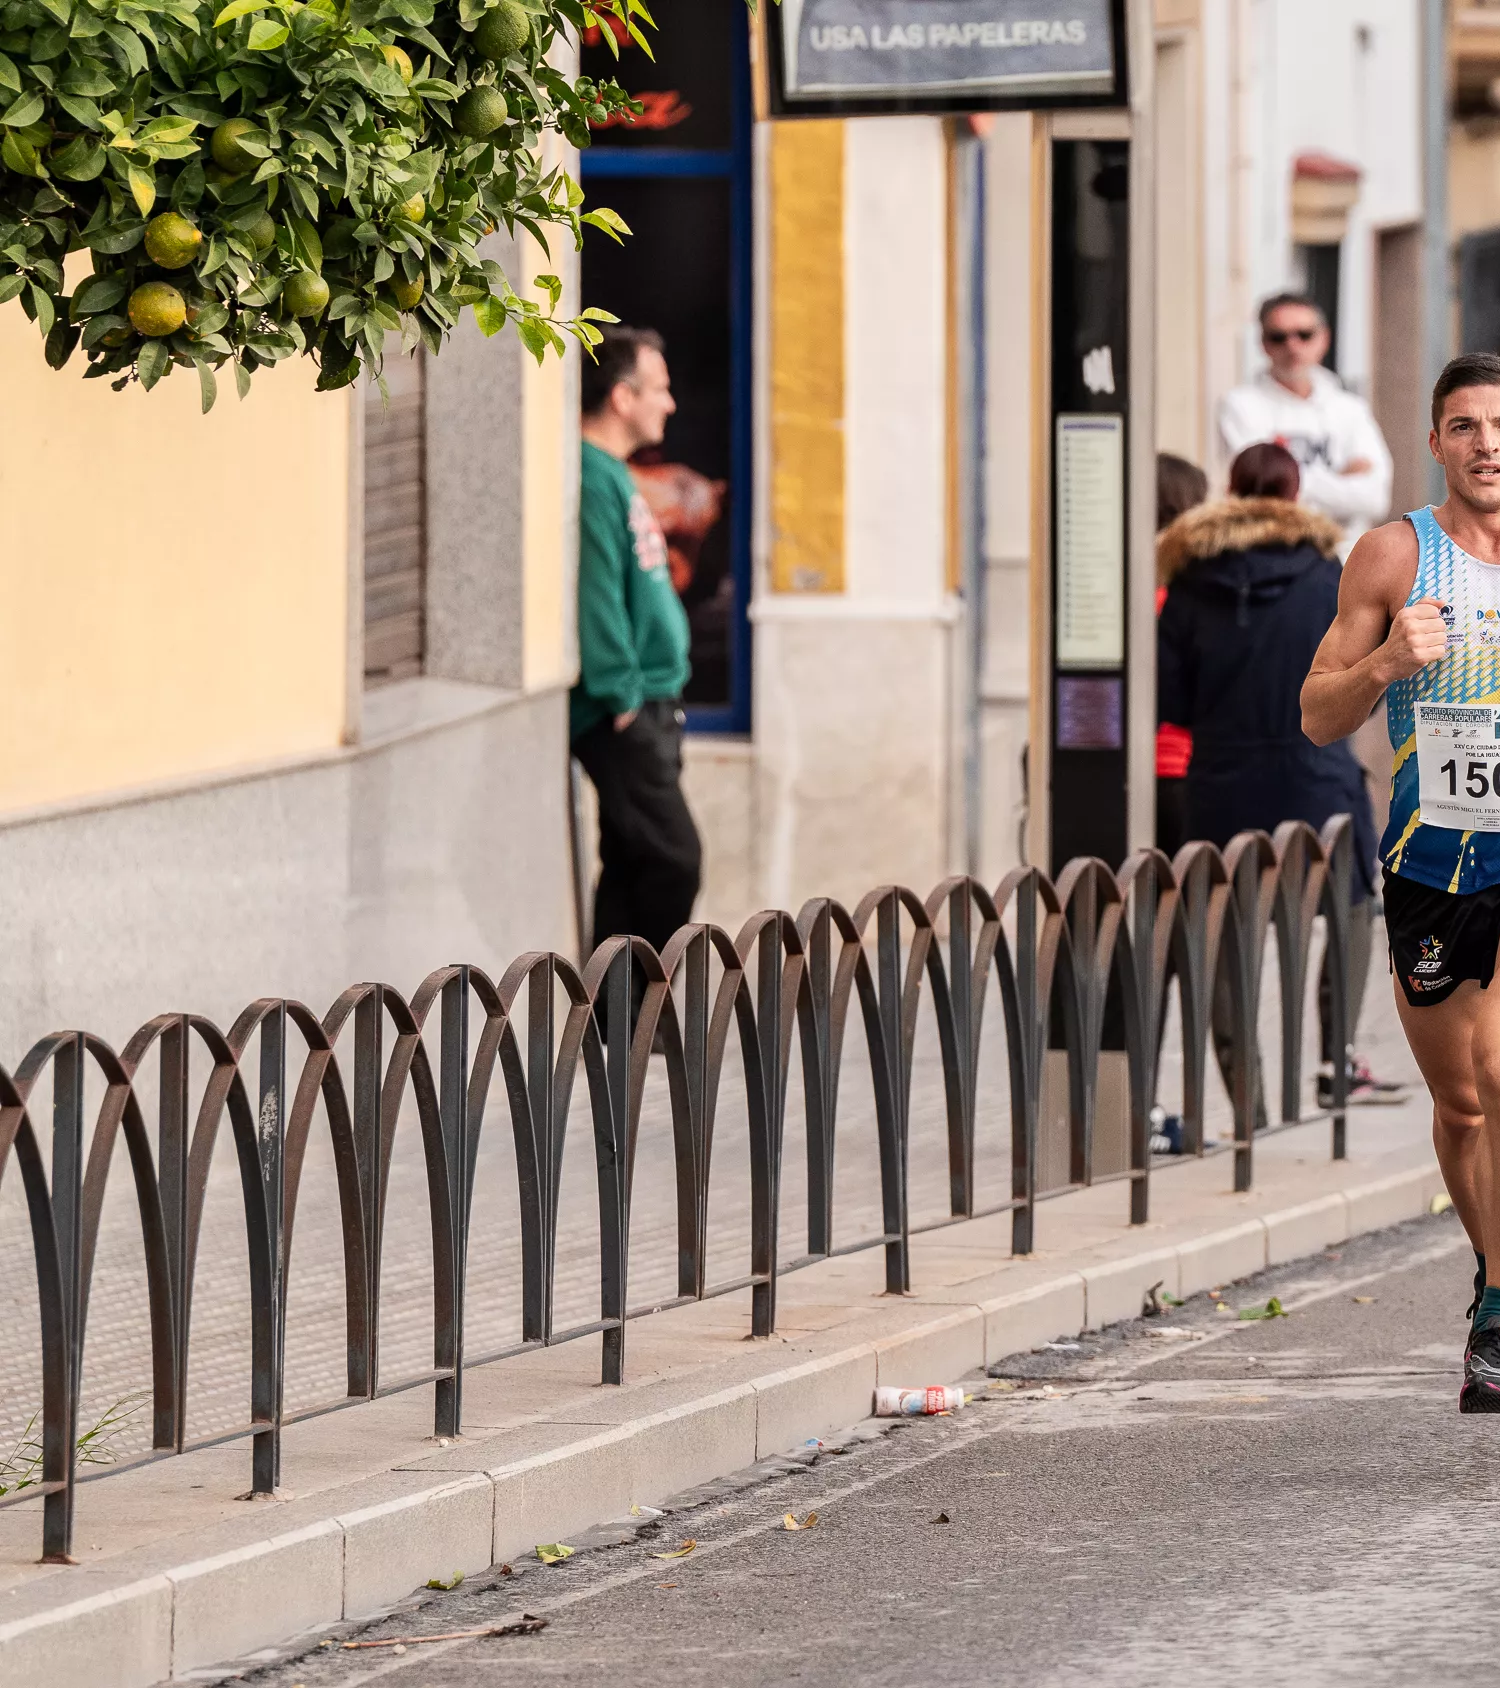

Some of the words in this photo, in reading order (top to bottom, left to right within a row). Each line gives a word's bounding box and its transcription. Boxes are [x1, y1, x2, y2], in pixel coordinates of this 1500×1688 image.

[811, 26, 867, 49] USA
[872, 24, 925, 48] LAS
[930, 20, 1087, 47] PAPELERAS
[1420, 707, 1446, 715] CIRCUITO
[1447, 708, 1482, 716] PROVINCIAL
[1420, 713, 1453, 721] CARRERAS
[1454, 715, 1492, 723] POPULARES
